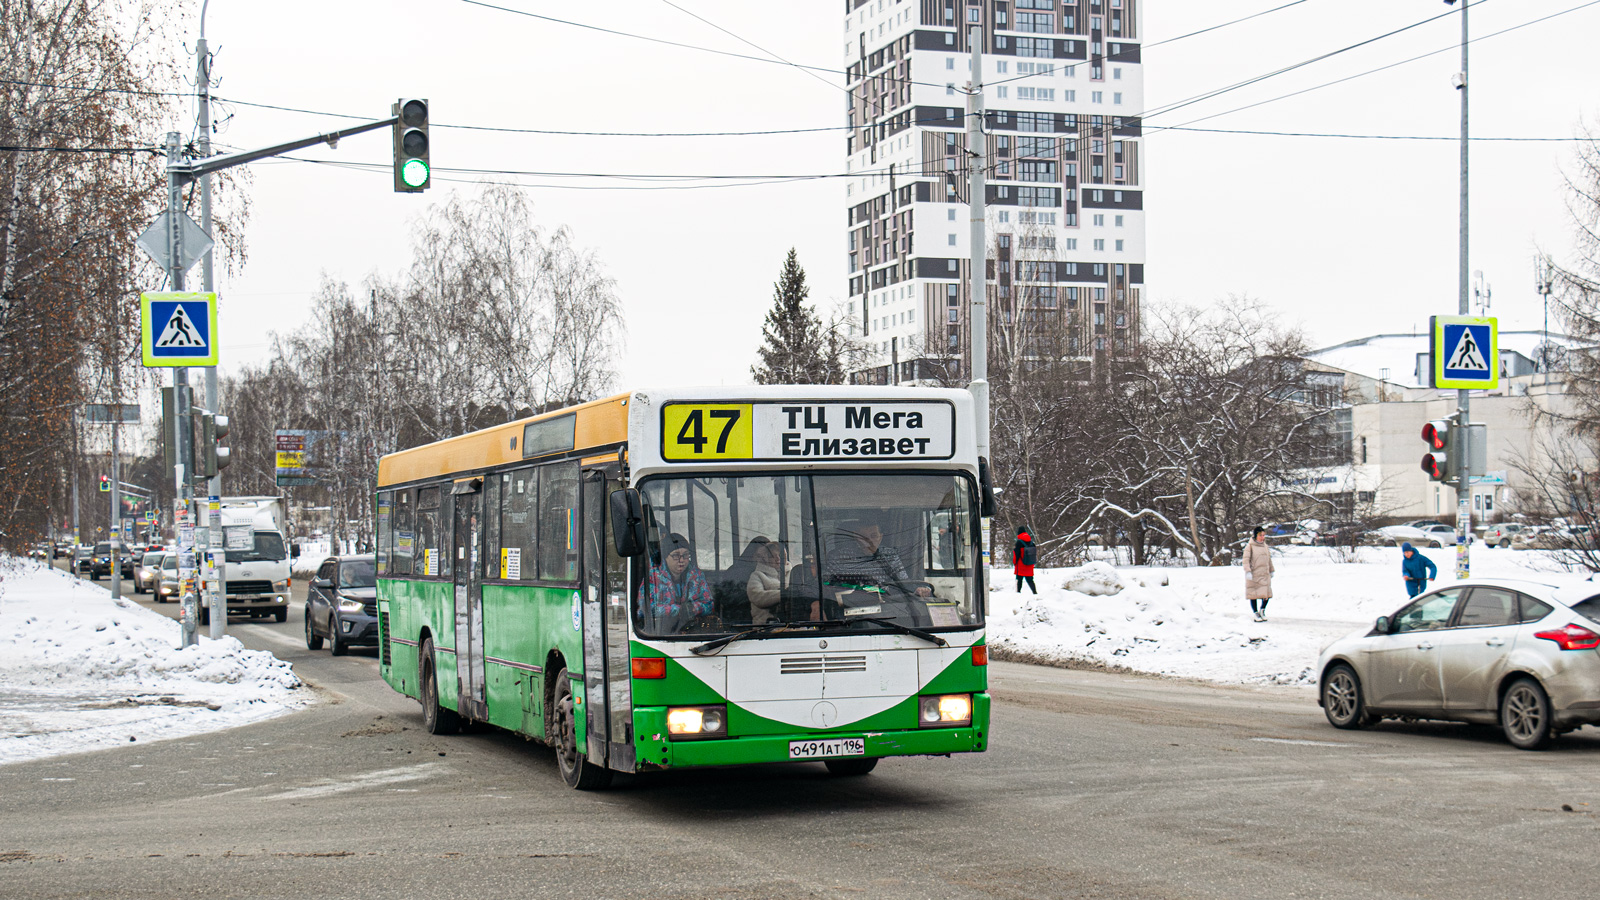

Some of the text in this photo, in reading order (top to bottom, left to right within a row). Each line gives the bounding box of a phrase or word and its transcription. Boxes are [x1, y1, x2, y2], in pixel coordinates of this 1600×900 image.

[676, 409, 741, 454] 47
[781, 406, 923, 433] ТЦ Мега
[781, 433, 931, 456] Елизавет
[843, 740, 861, 751] 196
